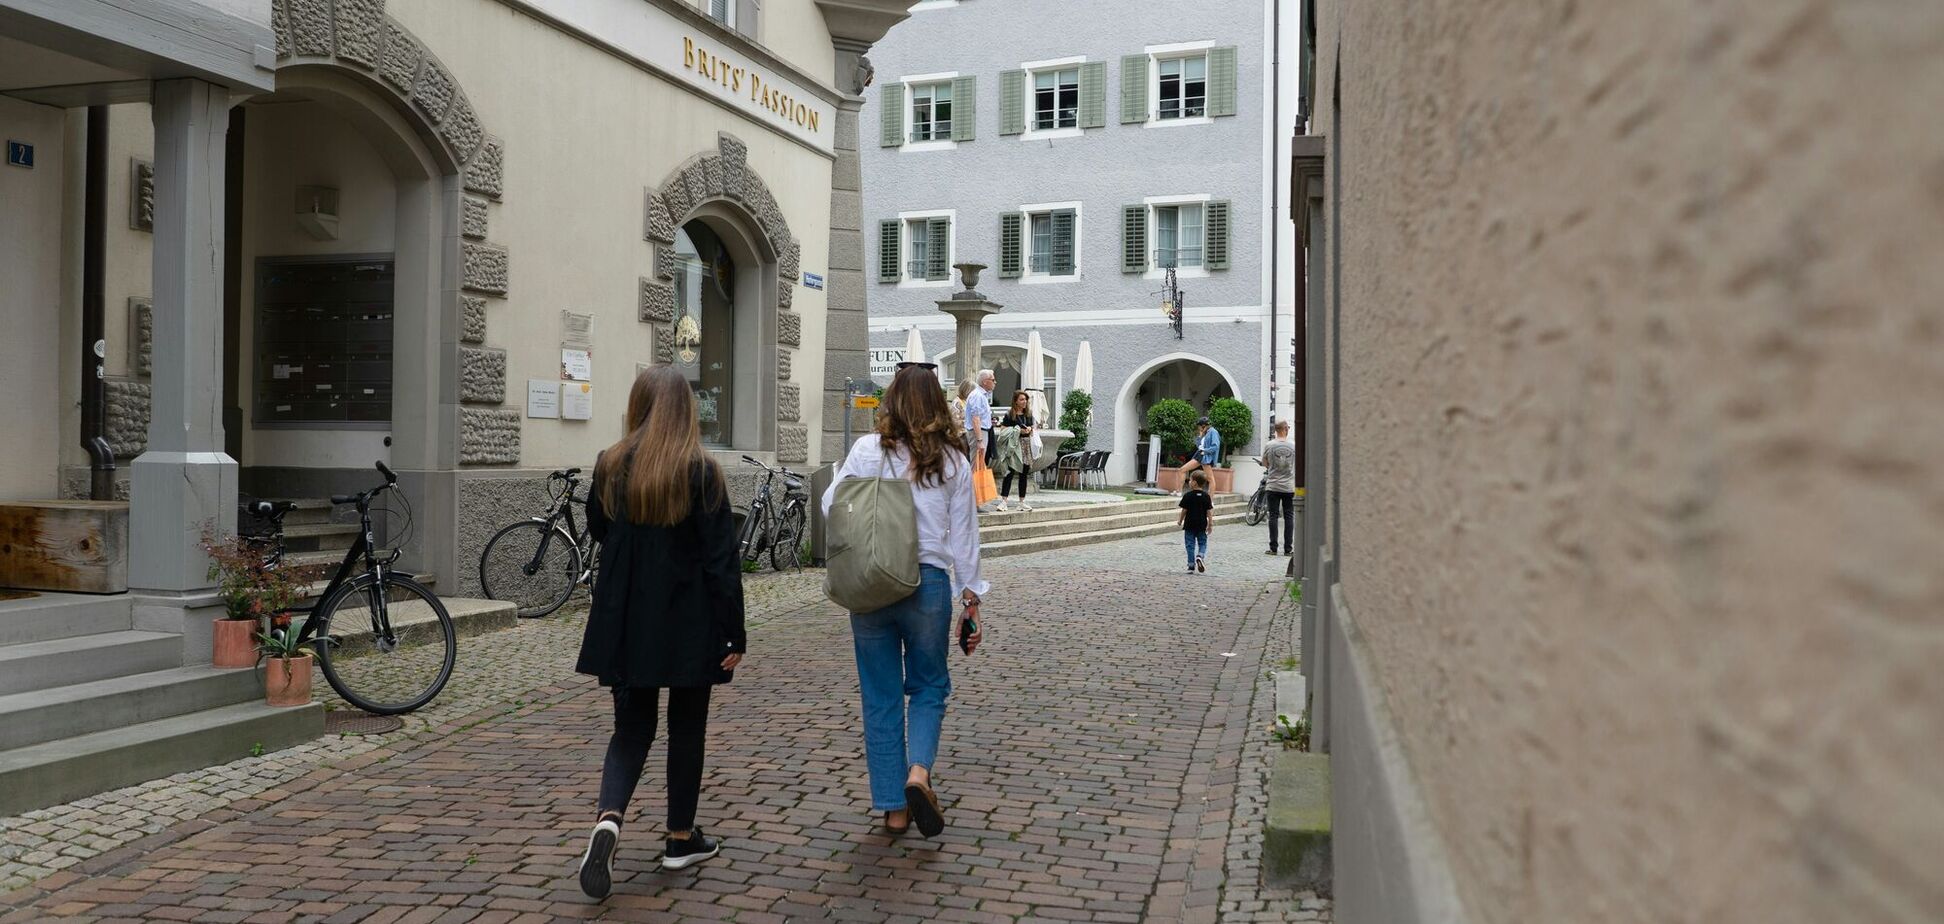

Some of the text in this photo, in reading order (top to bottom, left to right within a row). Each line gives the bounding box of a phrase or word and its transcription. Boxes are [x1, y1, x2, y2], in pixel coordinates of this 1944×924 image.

[683, 36, 820, 133] BRITS' PASSION
[19, 145, 26, 164] 2
